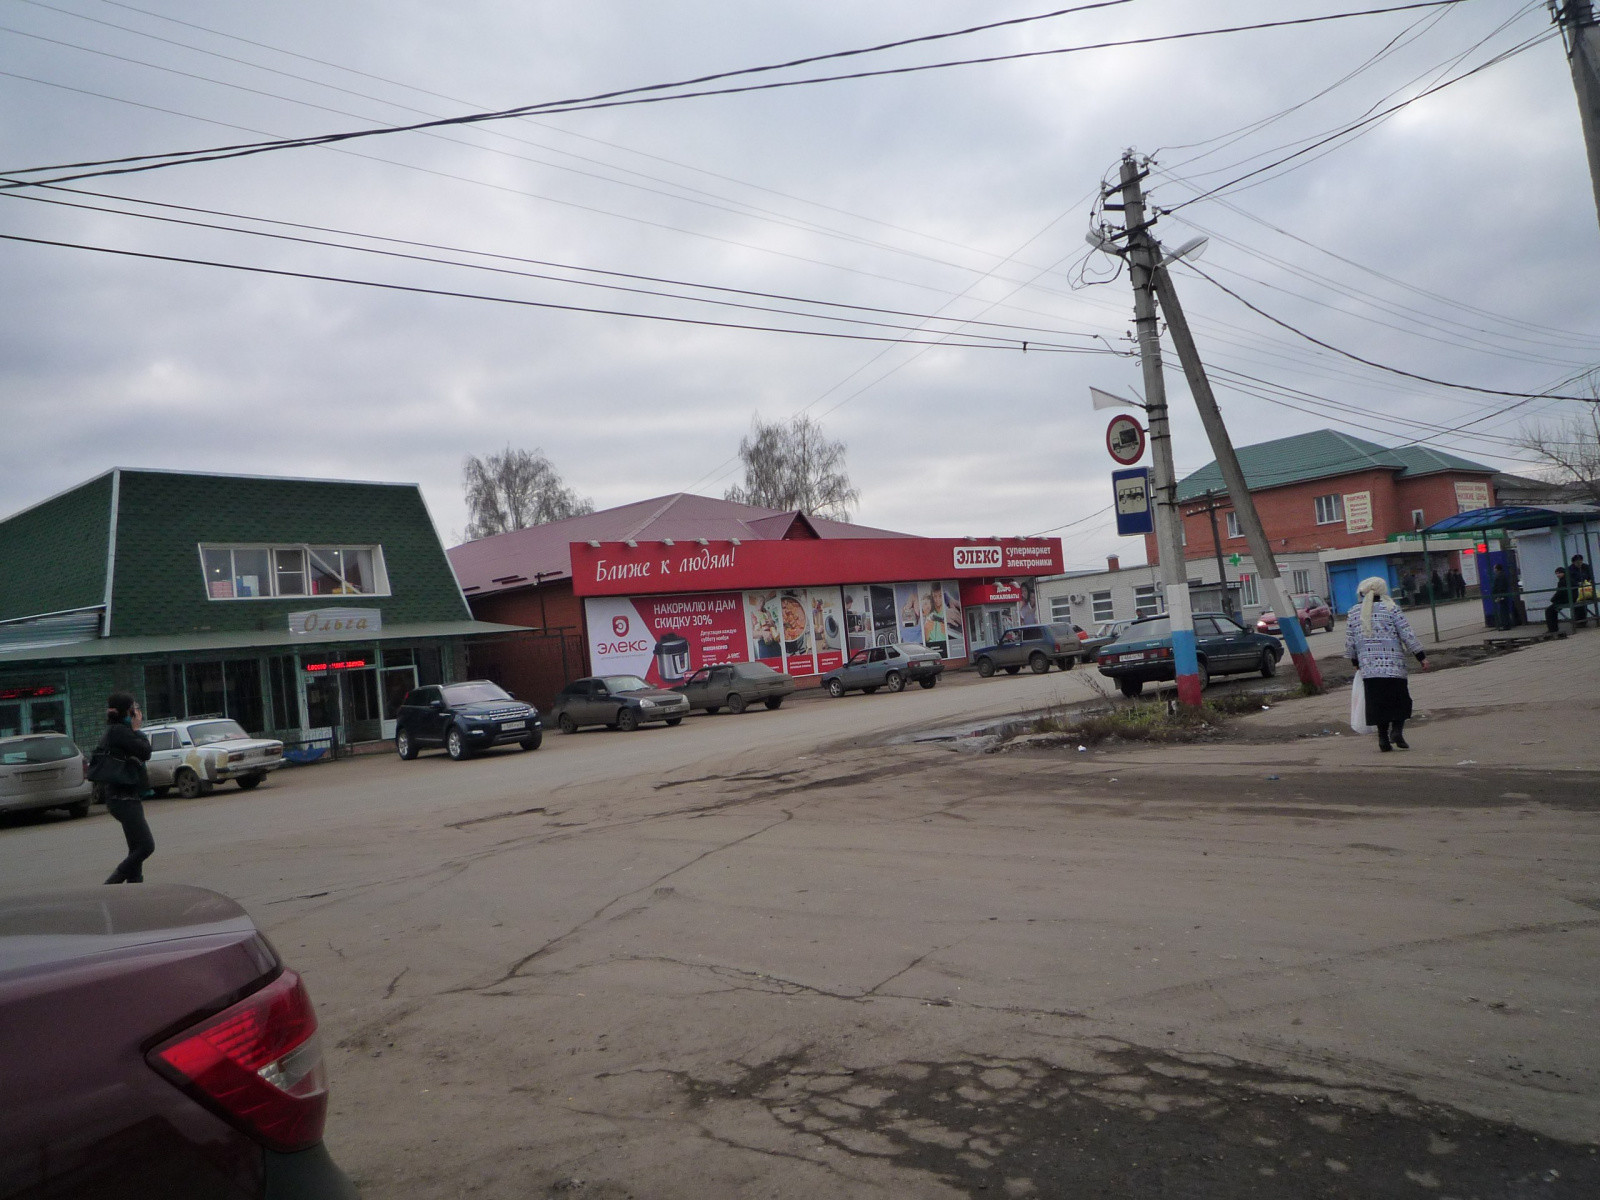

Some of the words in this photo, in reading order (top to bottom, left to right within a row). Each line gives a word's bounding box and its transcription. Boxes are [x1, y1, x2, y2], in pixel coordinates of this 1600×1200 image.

[956, 549, 1000, 565] ЭЛЕКС
[1005, 547, 1051, 557] супермаркет
[596, 560, 651, 582] Ближе
[661, 559, 670, 574] к
[679, 547, 735, 573] людям!
[1007, 559, 1053, 569] электроники
[653, 601, 706, 615] НАКОРМЛЮ
[707, 601, 714, 612] И
[715, 600, 736, 612] ДАМ
[304, 614, 368, 631] Ольга
[654, 615, 691, 630] СКИДКУ
[692, 614, 713, 627] 30%
